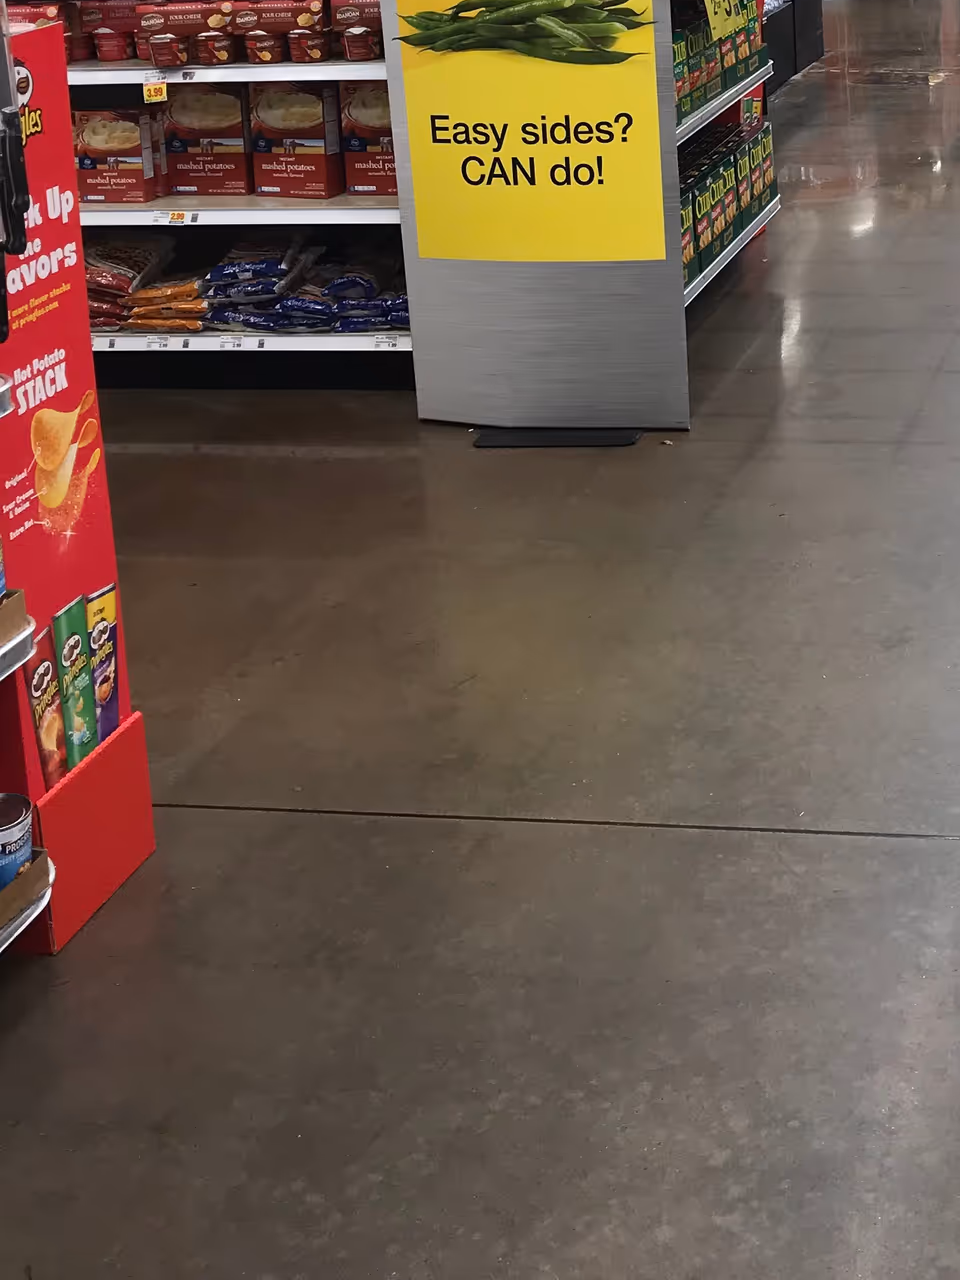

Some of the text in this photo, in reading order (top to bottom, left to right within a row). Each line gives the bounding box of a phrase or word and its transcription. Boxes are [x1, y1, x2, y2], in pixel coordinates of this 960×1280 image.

[141, 17, 165, 27] IDAHOAN
[236, 15, 258, 24] IDAHOAN
[336, 10, 360, 21] IDAHOAN
[146, 87, 164, 99] 3.99
[430, 111, 633, 152] Easy sides?
[177, 161, 236, 172] mashed potatoes
[261, 163, 316, 174] mashed potatoes
[355, 160, 381, 169] mashed
[460, 154, 605, 187] CAN do!
[86, 175, 137, 187] mashed potatoes
[46, 185, 74, 224] Up
[170, 213, 185, 221] 2.99
[12, 282, 71, 318] more flavor stacks
[12, 301, 59, 330] at pringles.com
[13, 346, 66, 386] Hot Potato
[16, 360, 69, 416] STACK
[4, 468, 28, 490] Original
[2, 488, 34, 514] Sour Cream
[90, 640, 114, 670] Pringles
[62, 652, 87, 697] Pringles
